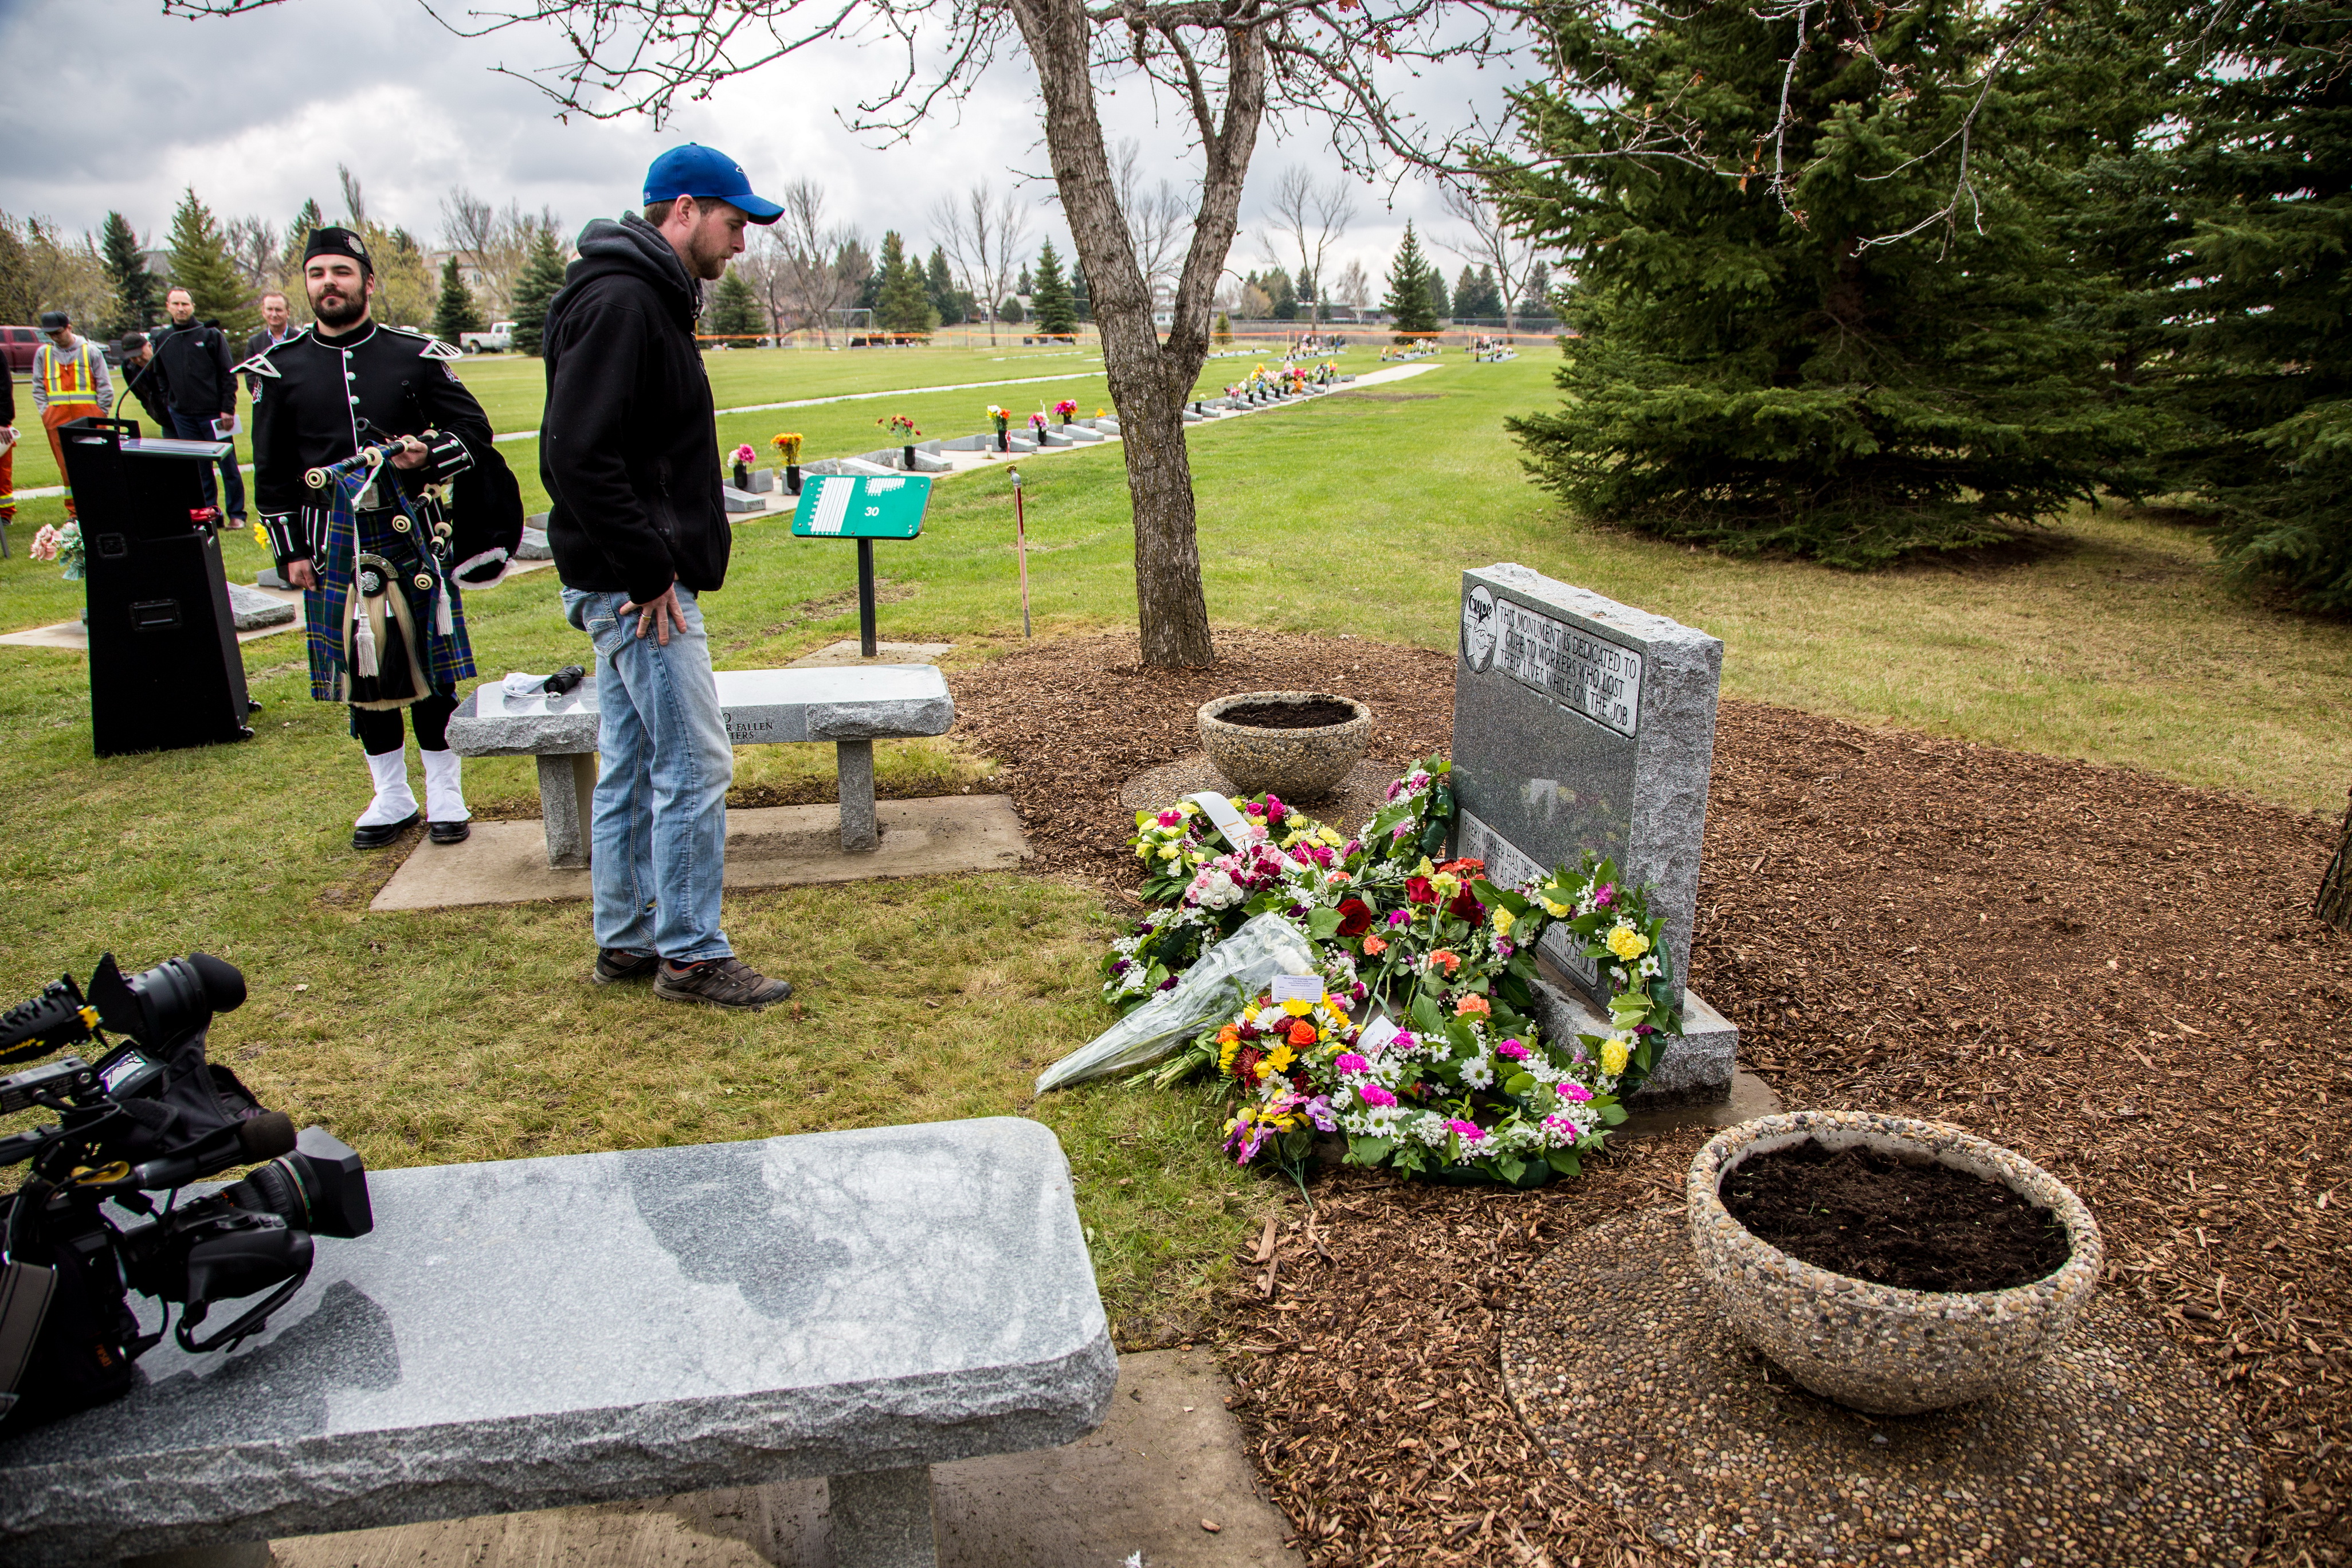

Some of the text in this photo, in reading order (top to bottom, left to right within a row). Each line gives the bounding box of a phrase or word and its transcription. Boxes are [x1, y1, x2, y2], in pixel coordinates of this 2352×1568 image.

[864, 507, 880, 516] 30
[1500, 606, 1636, 679] THIS MONUMENT IS DEDICATED TO
[1506, 630, 1624, 699] CUPE 70 WORKERS WHO LOST
[1500, 649, 1628, 726] THEIR LIVES WHILE ON THE JOB
[727, 731, 754, 739] TERS
[736, 722, 773, 731] FALLEN
[1464, 816, 1532, 880] EVERY WORKER HAS THE
[1467, 838, 1481, 860] FROM
[1482, 850, 1499, 877] WORK
[1499, 865, 1507, 883] AS
